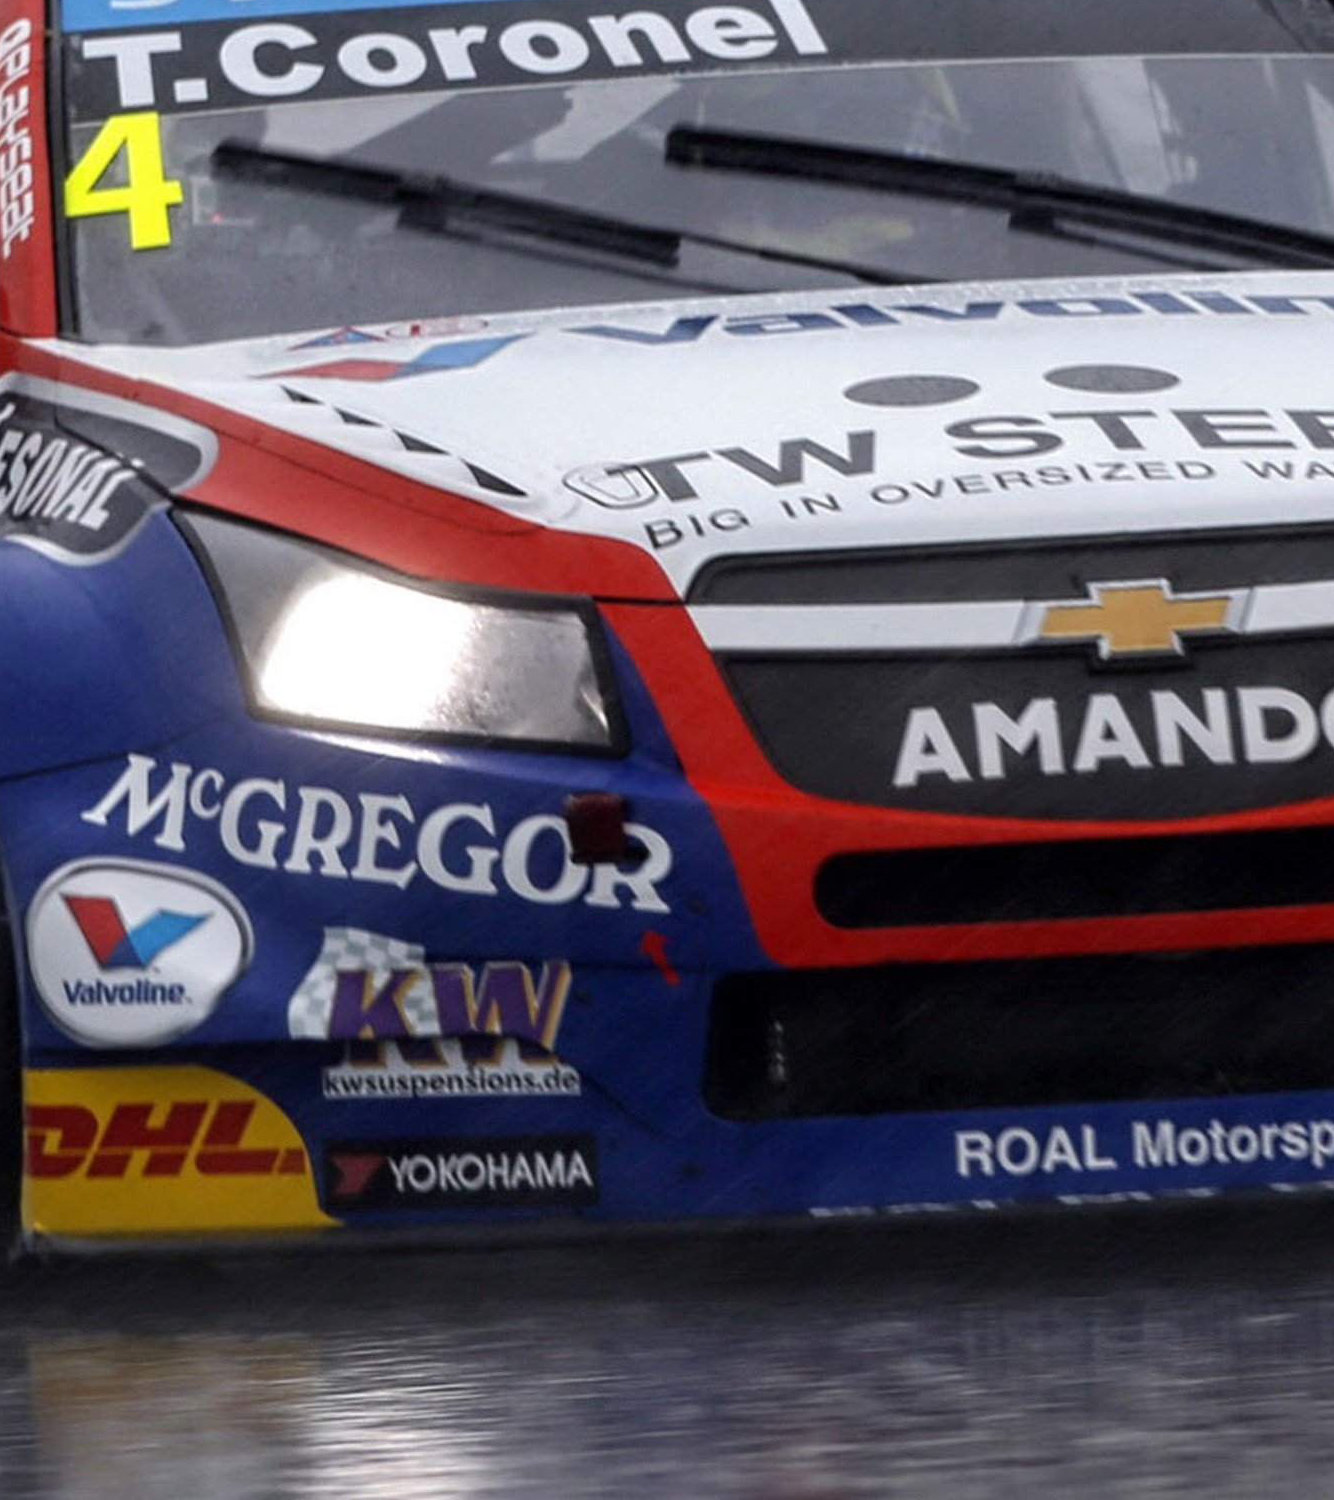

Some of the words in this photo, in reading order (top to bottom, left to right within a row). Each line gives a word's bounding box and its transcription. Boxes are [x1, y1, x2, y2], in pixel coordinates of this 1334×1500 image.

[65, 111, 184, 251] 4
[608, 429, 875, 501] TW
[643, 508, 750, 550] BIG
[780, 492, 842, 519] IN
[870, 460, 1216, 504] OVERSIZED
[63, 980, 187, 1006] Valvoline
[324, 960, 573, 1068] KW
[387, 1151, 594, 1195] YOKOHAMA
[954, 1124, 1118, 1178] ROAL
